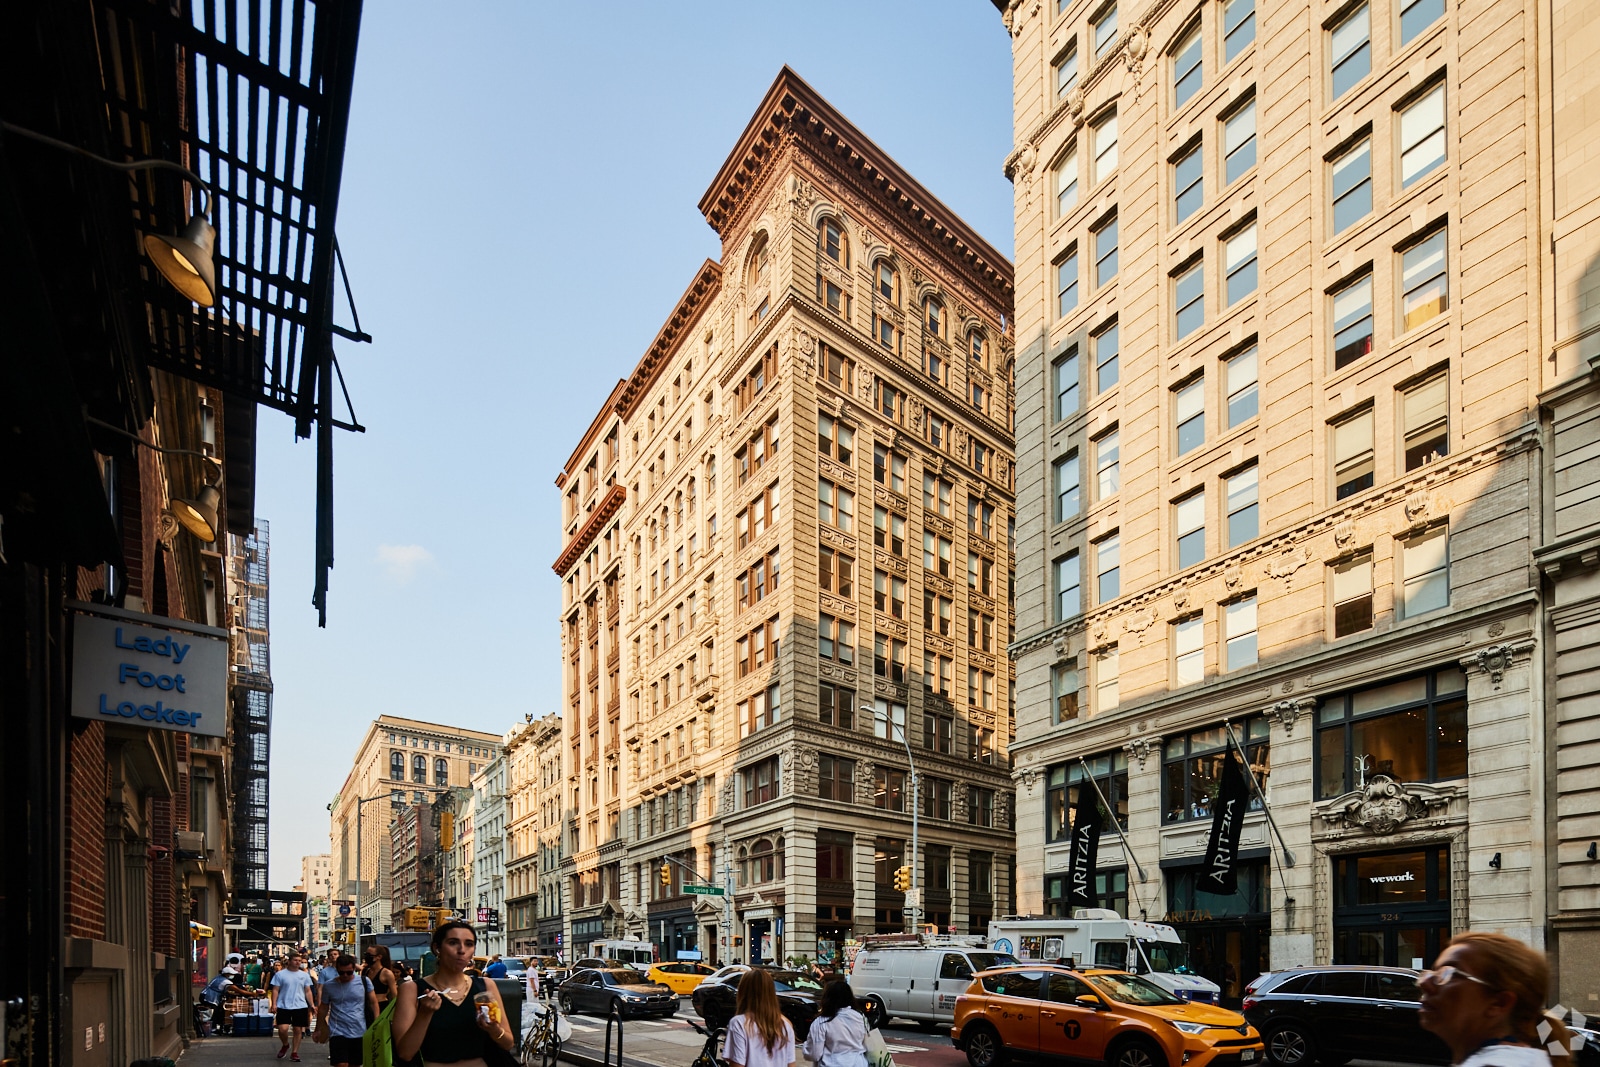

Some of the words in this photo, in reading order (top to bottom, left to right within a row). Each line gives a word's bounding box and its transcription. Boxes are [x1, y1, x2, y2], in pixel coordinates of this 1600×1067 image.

[115, 627, 191, 664] Lady
[119, 662, 186, 694] Foot
[99, 693, 202, 728] Locker
[1209, 799, 1236, 884] ARITZIA
[1073, 824, 1092, 898] ARITZIA
[1369, 871, 1415, 883] wework
[693, 887, 709, 895] Spring
[1162, 909, 1213, 922] ARITZIA
[1381, 913, 1399, 921] 524
